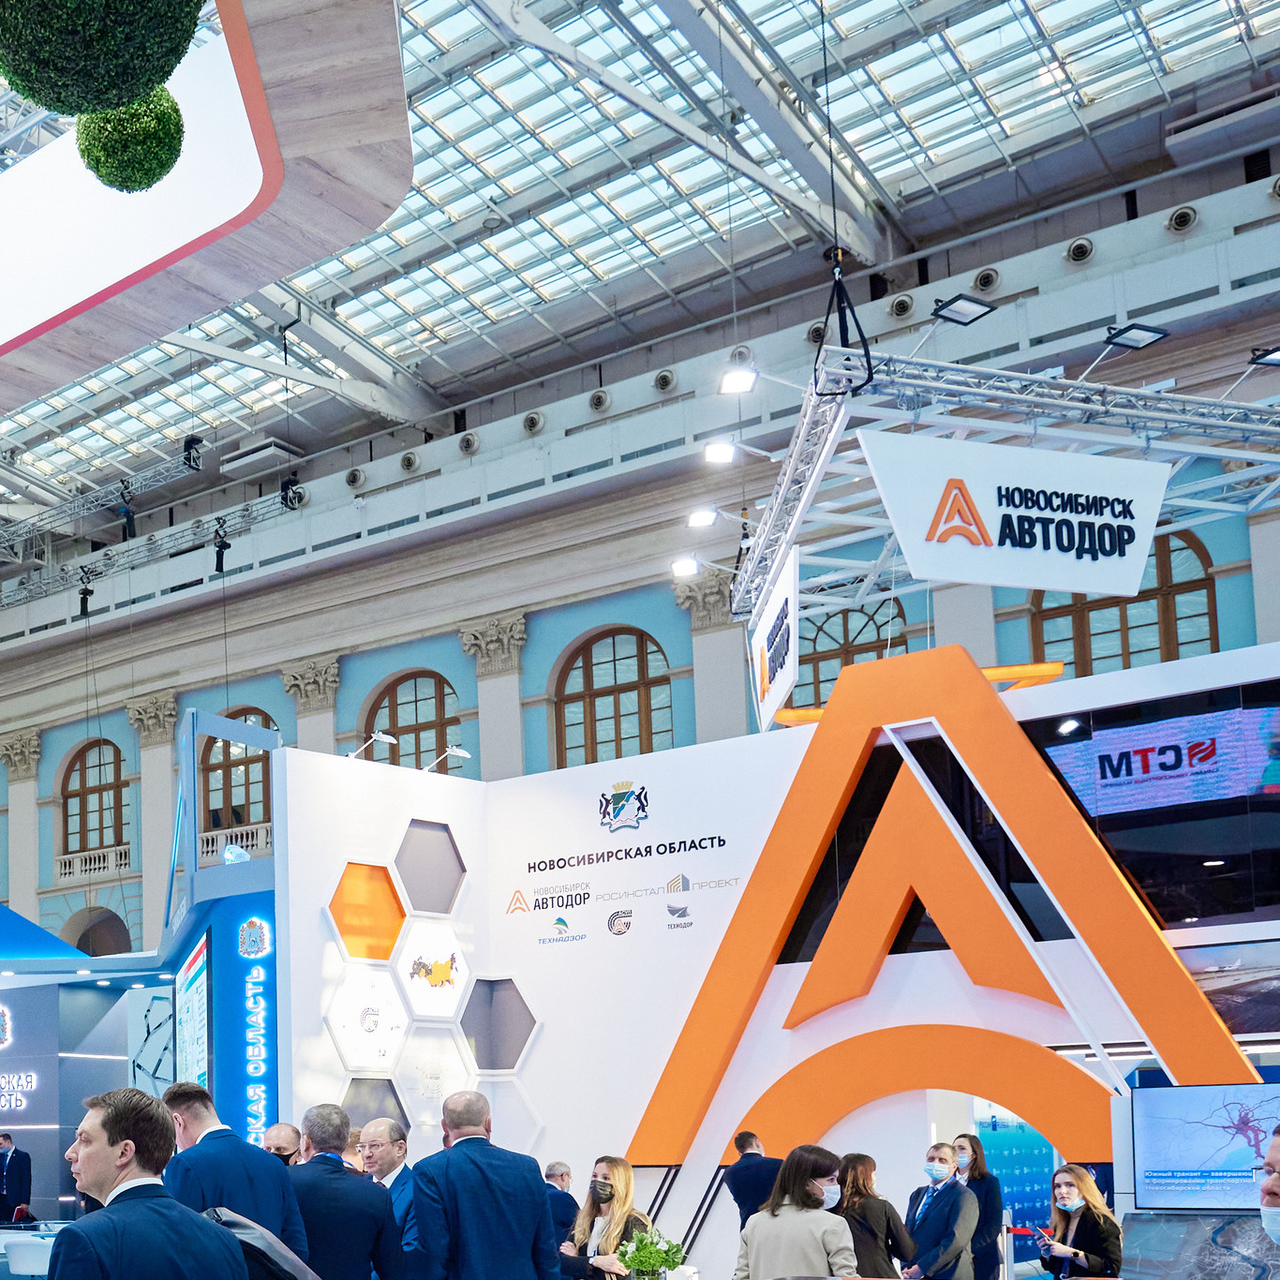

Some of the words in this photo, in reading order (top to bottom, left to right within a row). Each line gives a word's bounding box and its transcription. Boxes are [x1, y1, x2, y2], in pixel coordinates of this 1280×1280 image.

[997, 485, 1136, 520] НОВОСИБИРСК
[997, 513, 1136, 562] АВТОДОР
[527, 845, 653, 874] НОВОСИБИРСКАЯ
[655, 834, 727, 856] ОБЛАСТЬ
[533, 882, 591, 897] НОВОСИБИРСК
[692, 877, 741, 891] ПРОЕКТ
[533, 892, 591, 911] АВТОДОР
[537, 934, 587, 945] ТЕХНАДЗОР
[245, 966, 267, 1077] ОБЛАСТЬ
